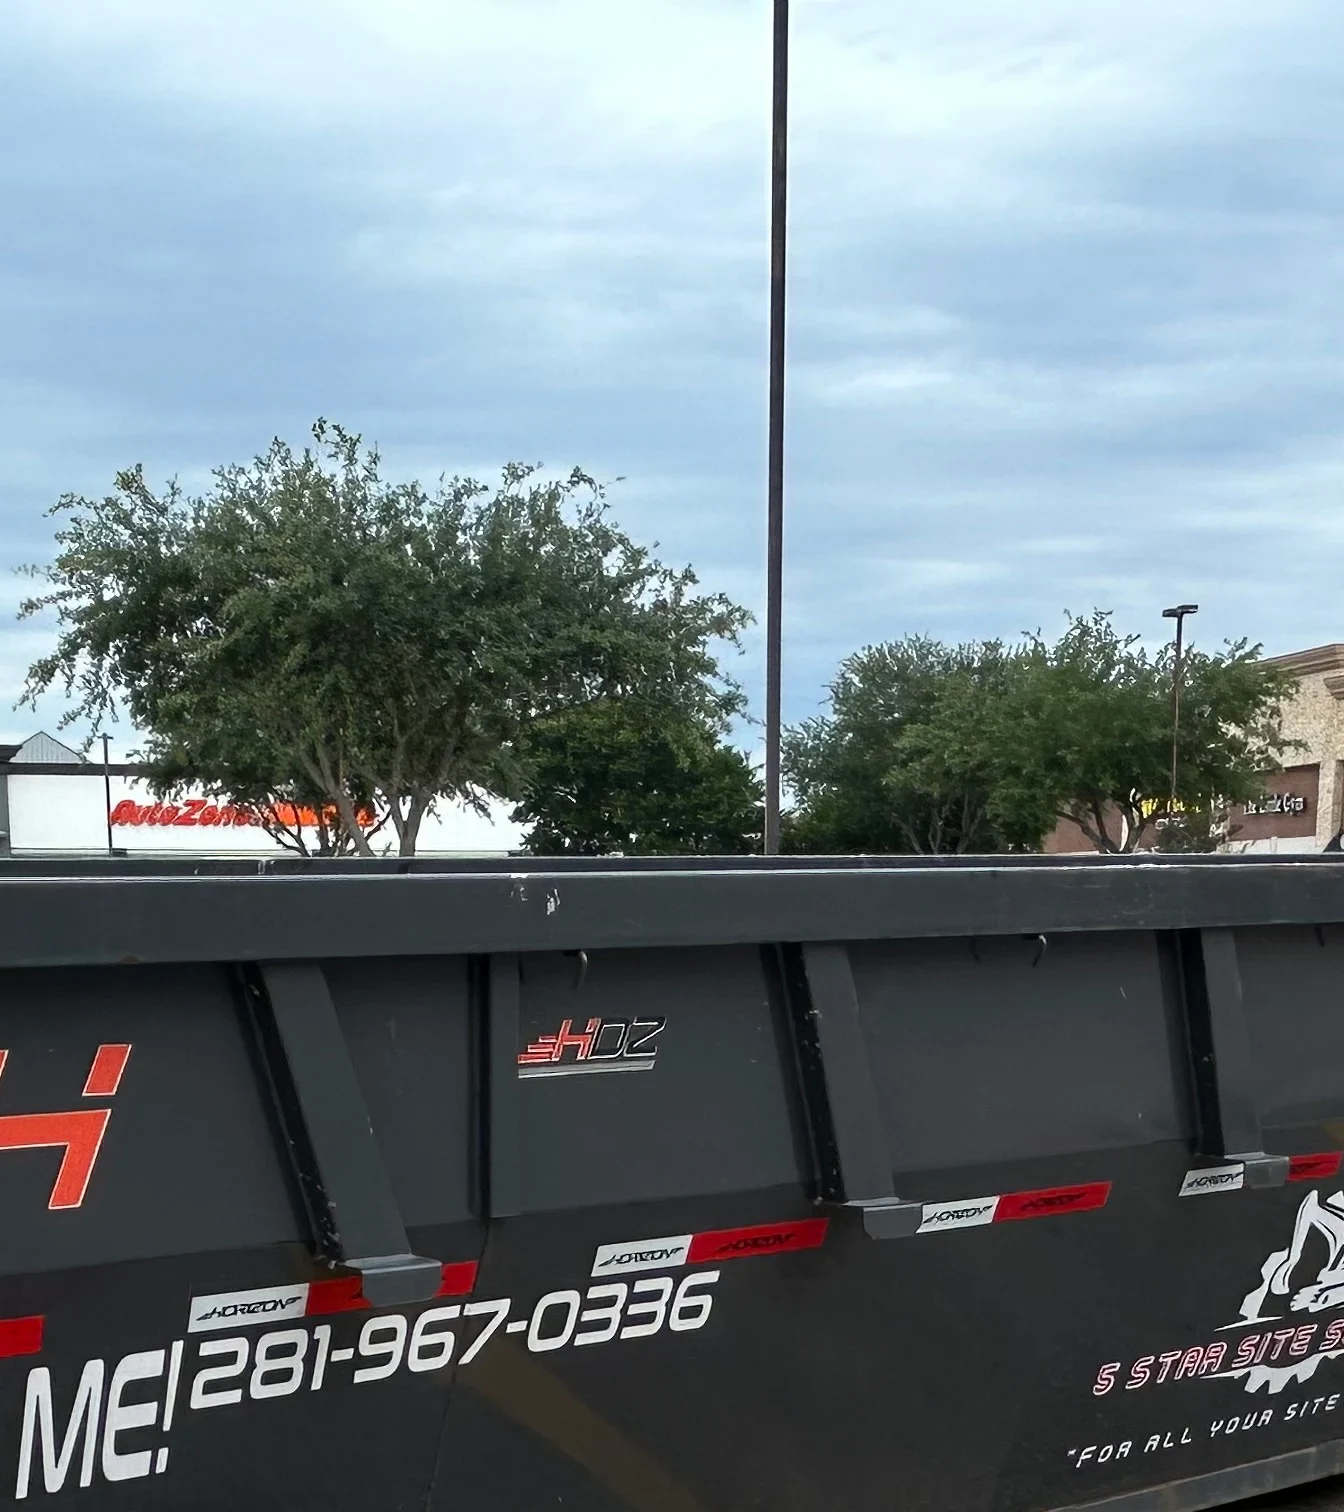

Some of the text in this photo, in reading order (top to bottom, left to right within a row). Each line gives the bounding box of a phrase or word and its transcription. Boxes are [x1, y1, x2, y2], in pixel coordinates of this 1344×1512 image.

[190, 1269, 721, 1410] 281-967-0336
[196, 1296, 302, 1321] HORIZON
[1093, 1362, 1121, 1396] 5
[1125, 1341, 1227, 1390] STAR
[1231, 1324, 1318, 1370] SITE
[15, 1339, 184, 1500] ME!
[1143, 1427, 1193, 1454] ALL
[1210, 1409, 1274, 1440] YOUR
[1284, 1393, 1341, 1421] SITE
